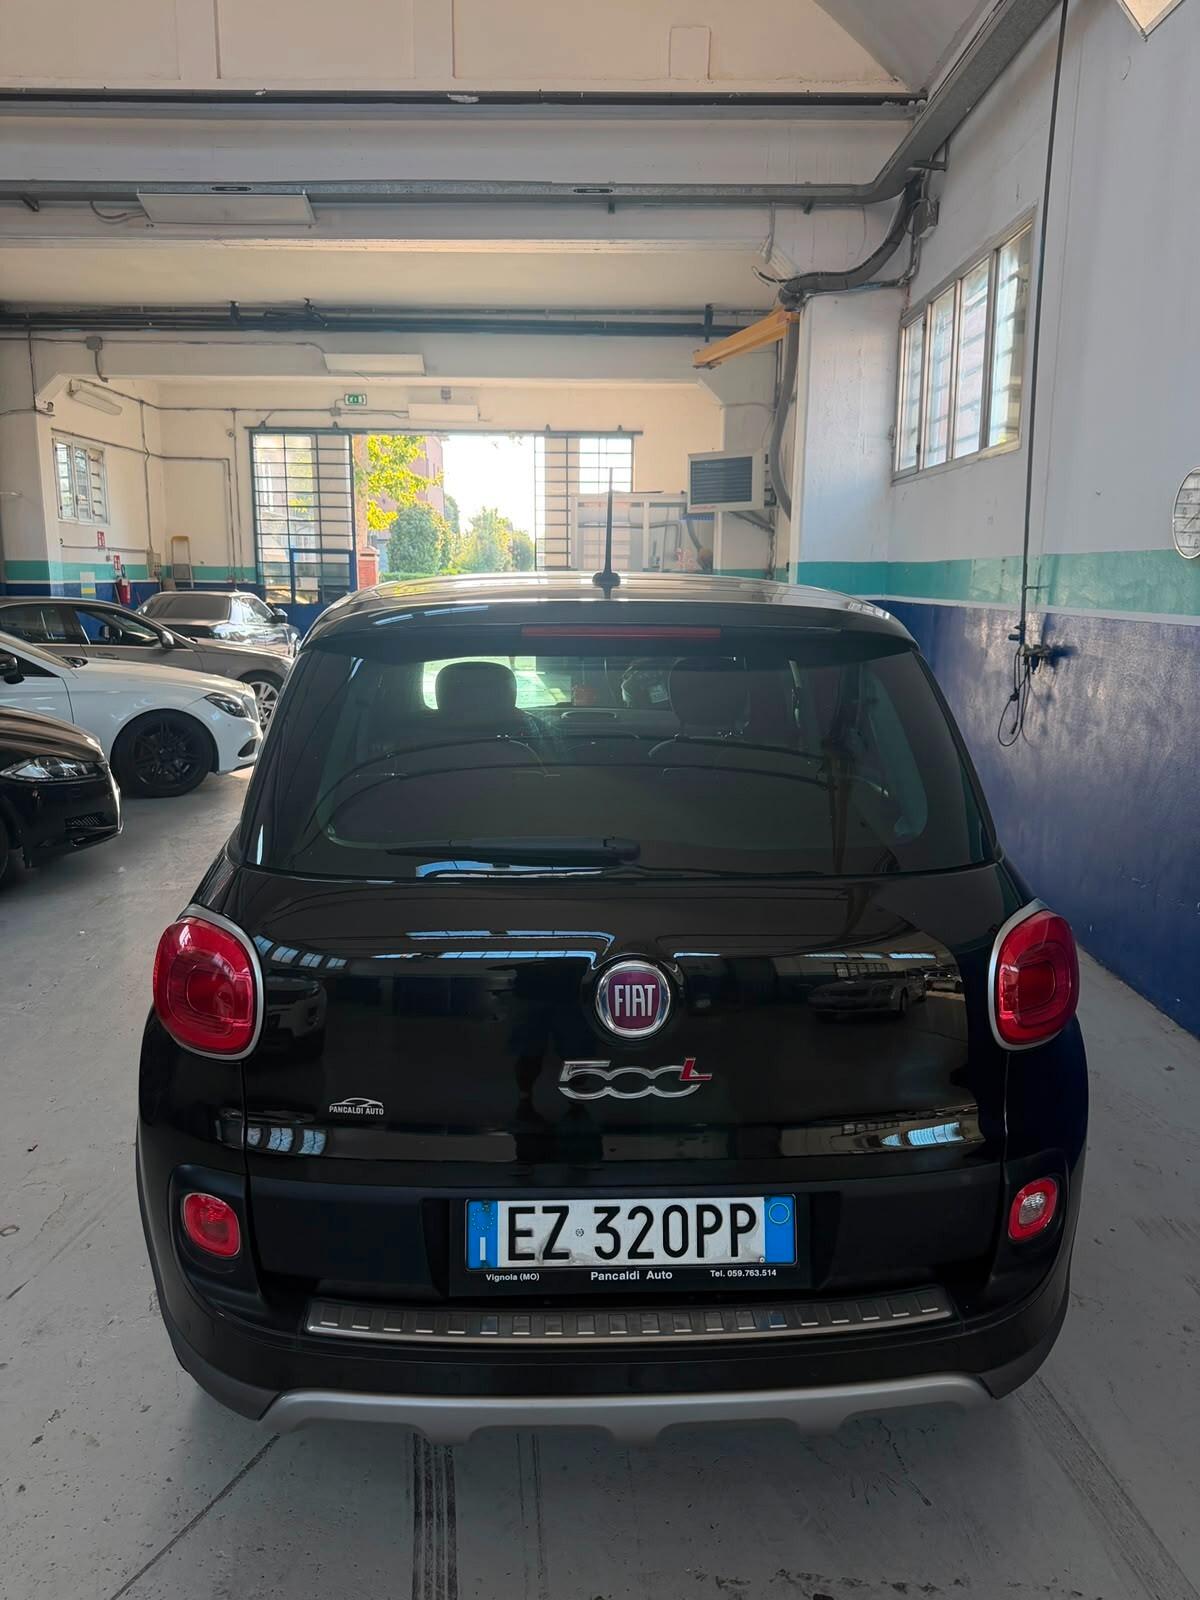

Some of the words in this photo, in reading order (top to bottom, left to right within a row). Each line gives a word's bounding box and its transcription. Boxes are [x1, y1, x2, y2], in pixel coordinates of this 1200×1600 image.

[614, 984, 656, 1017] FIAT
[558, 1056, 713, 1101] 500L
[328, 1105, 364, 1115] PANCALDI
[365, 1107, 385, 1116] AUTO
[508, 1205, 570, 1261] EZ
[593, 1203, 757, 1260] 320PP
[479, 1236, 487, 1261] I
[486, 1273, 518, 1283] Vignola
[519, 1272, 540, 1281] (MO)
[590, 1271, 640, 1281] Pancaldi
[645, 1270, 673, 1280] Auto
[710, 1269, 726, 1277] Tel.
[727, 1269, 777, 1278] 059.763.514
